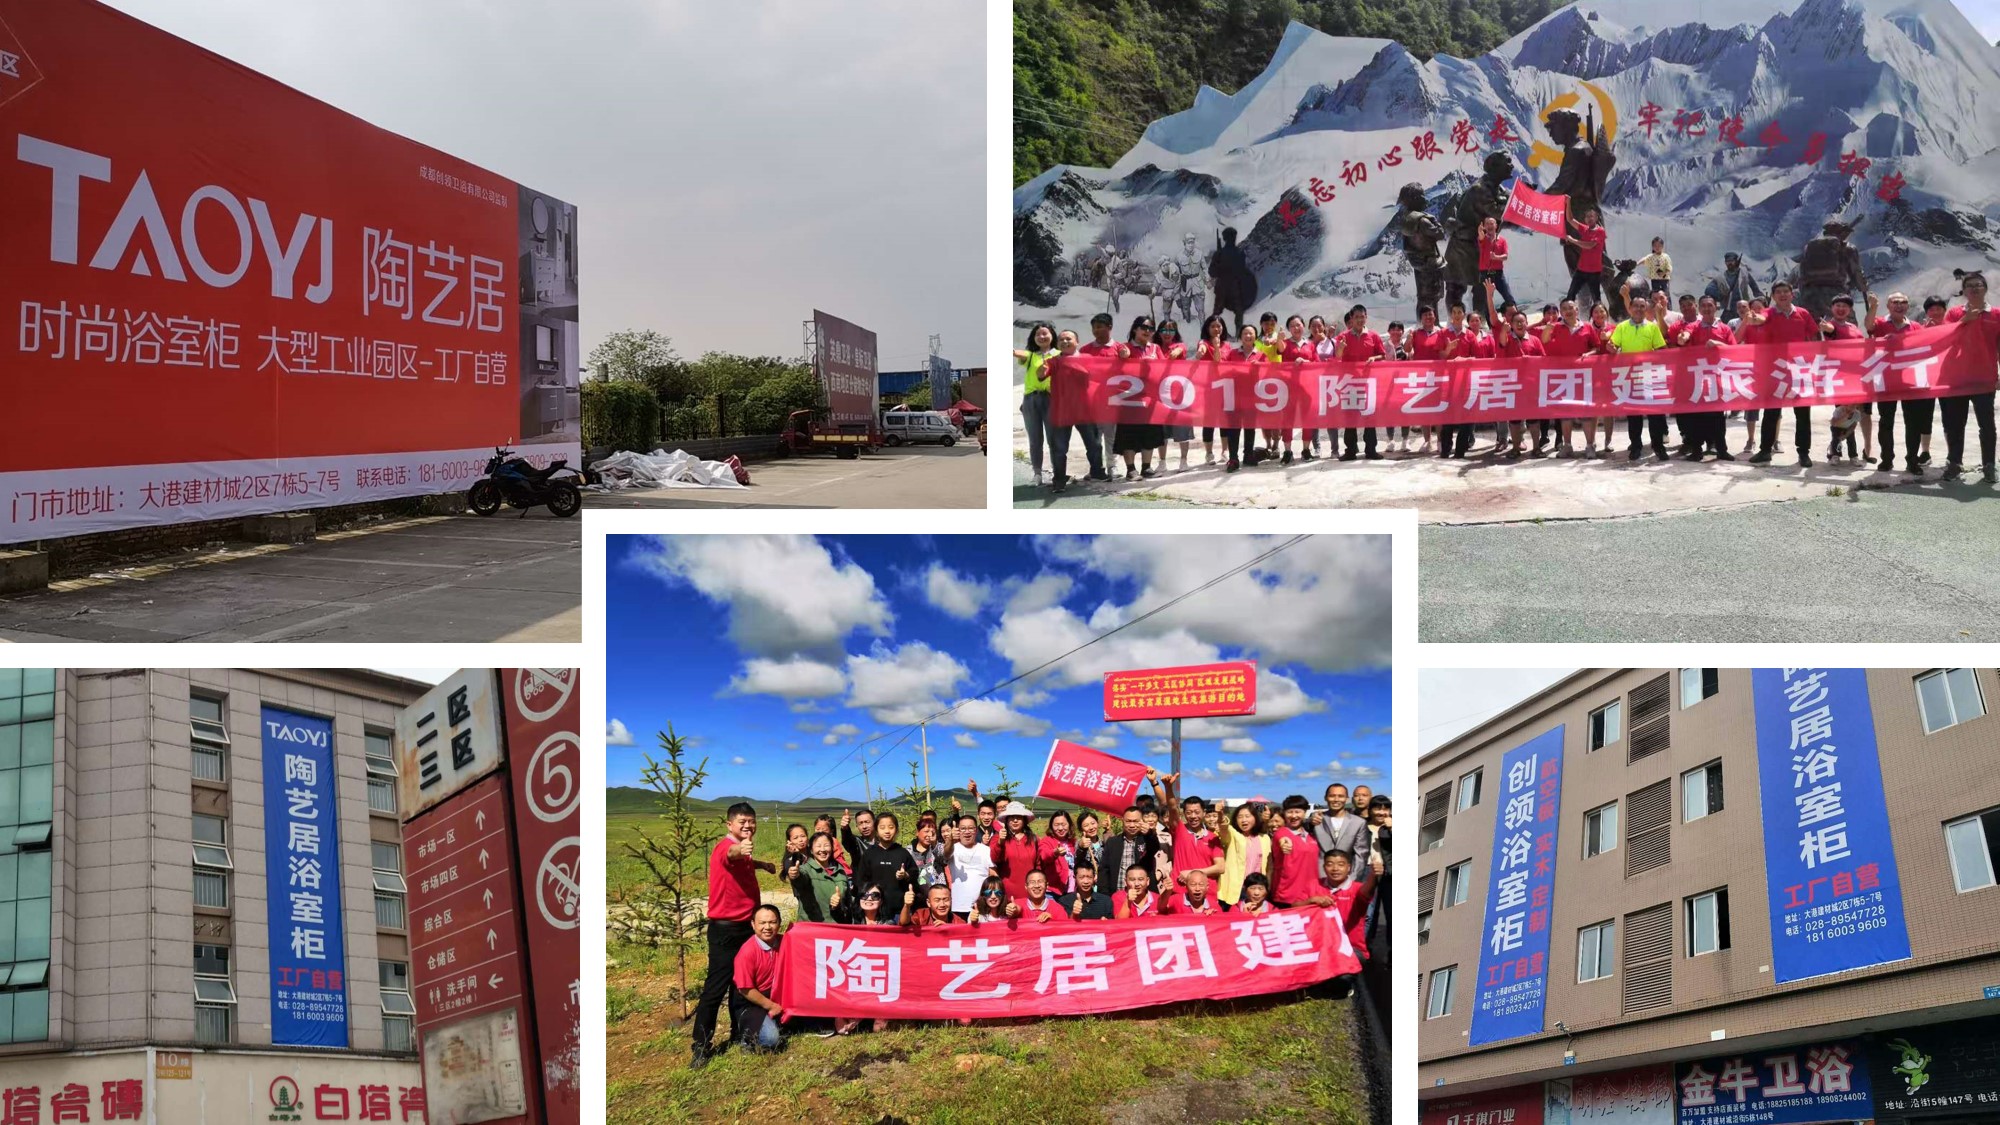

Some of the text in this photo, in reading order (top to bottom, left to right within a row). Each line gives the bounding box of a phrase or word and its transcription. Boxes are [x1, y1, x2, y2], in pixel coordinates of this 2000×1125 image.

[17, 133, 506, 333] TAOYJ 陶艺居
[19, 301, 507, 385] 时尚浴室柜 大型工业园区-工厂自营
[266, 721, 328, 748] TAOYJ
[543, 742, 573, 808] 5
[1048, 761, 1138, 798] 陶艺居浴室柜厂
[284, 754, 327, 961] 陶艺居浴室柜
[417, 828, 456, 859] 市场一区
[1490, 753, 1537, 955] 创领浴室柜
[420, 865, 459, 894] 市场四区
[1783, 862, 1881, 909] 工厂自营
[423, 909, 453, 932] 综合区
[427, 948, 456, 970] 仓储区
[1484, 951, 1544, 986] 工厂自营
[277, 966, 343, 990] 工厂自营
[446, 975, 478, 997] 洗手间
[1680, 1046, 1853, 1107] 金牛卫浴
